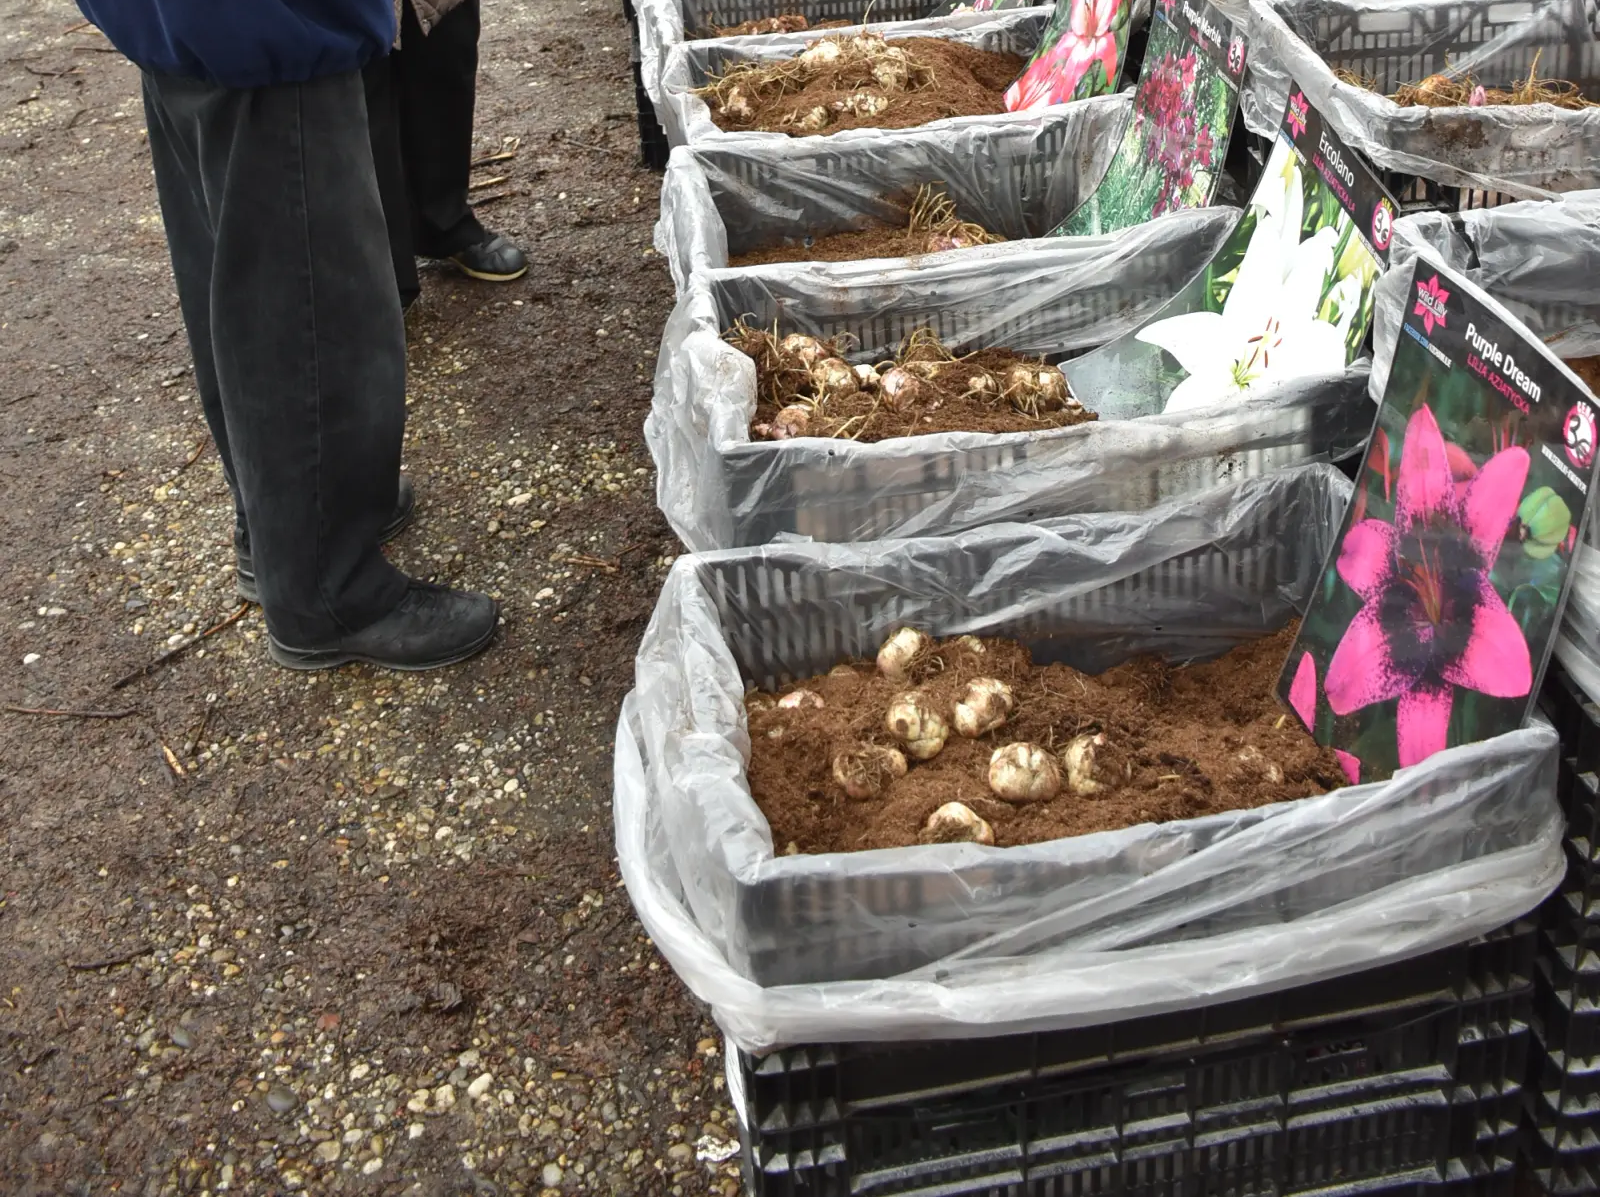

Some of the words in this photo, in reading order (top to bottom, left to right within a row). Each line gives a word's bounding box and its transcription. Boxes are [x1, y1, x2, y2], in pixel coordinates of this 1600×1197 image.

[1182, 0, 1201, 27] Purple
[1200, 16, 1222, 49] Marble
[1318, 130, 1354, 187] Ercolano
[1418, 285, 1435, 306] Wild
[1464, 322, 1503, 367] Purple
[1502, 354, 1541, 403] Dream
[1467, 352, 1488, 378] LILIA
